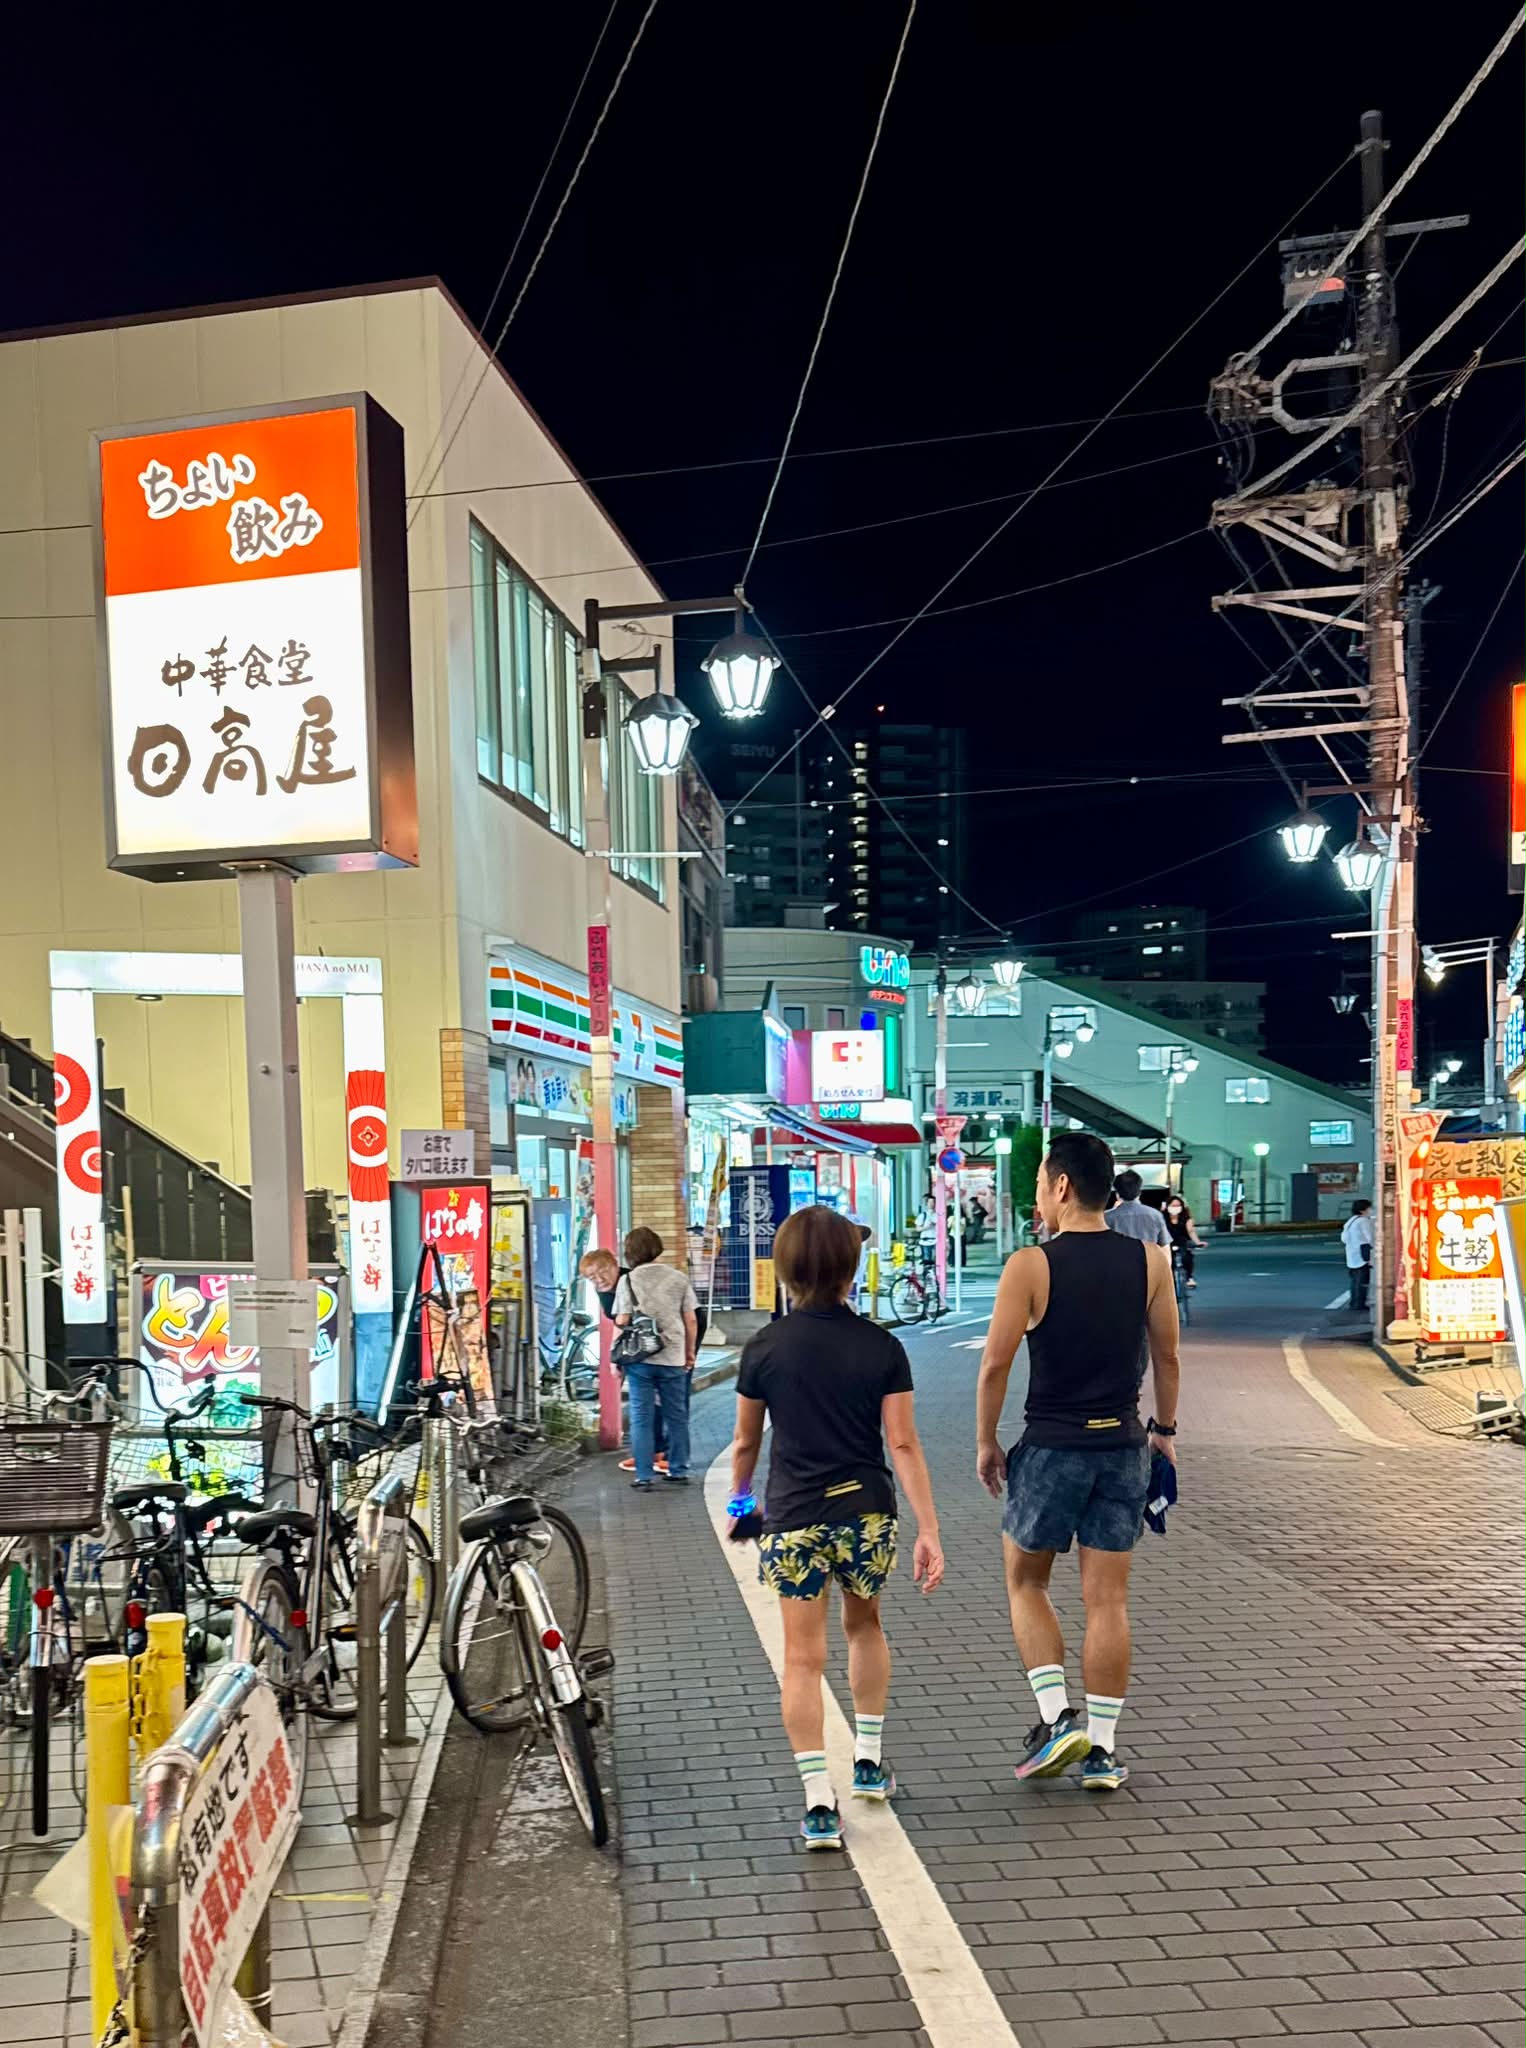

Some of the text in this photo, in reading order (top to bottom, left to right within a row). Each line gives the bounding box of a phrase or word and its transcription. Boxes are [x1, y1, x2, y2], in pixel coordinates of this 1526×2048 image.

[141, 454, 253, 516] ちょい
[231, 497, 319, 559] 飲み
[160, 635, 314, 697] 中華食堂
[127, 695, 358, 798] 日高屋
[332, 965, 345, 973] no
[347, 963, 369, 974] MAI
[405, 1157, 469, 1176] タバコ吸えます
[738, 1223, 776, 1237] BSS
[1438, 1236, 1490, 1267] 牛繁
